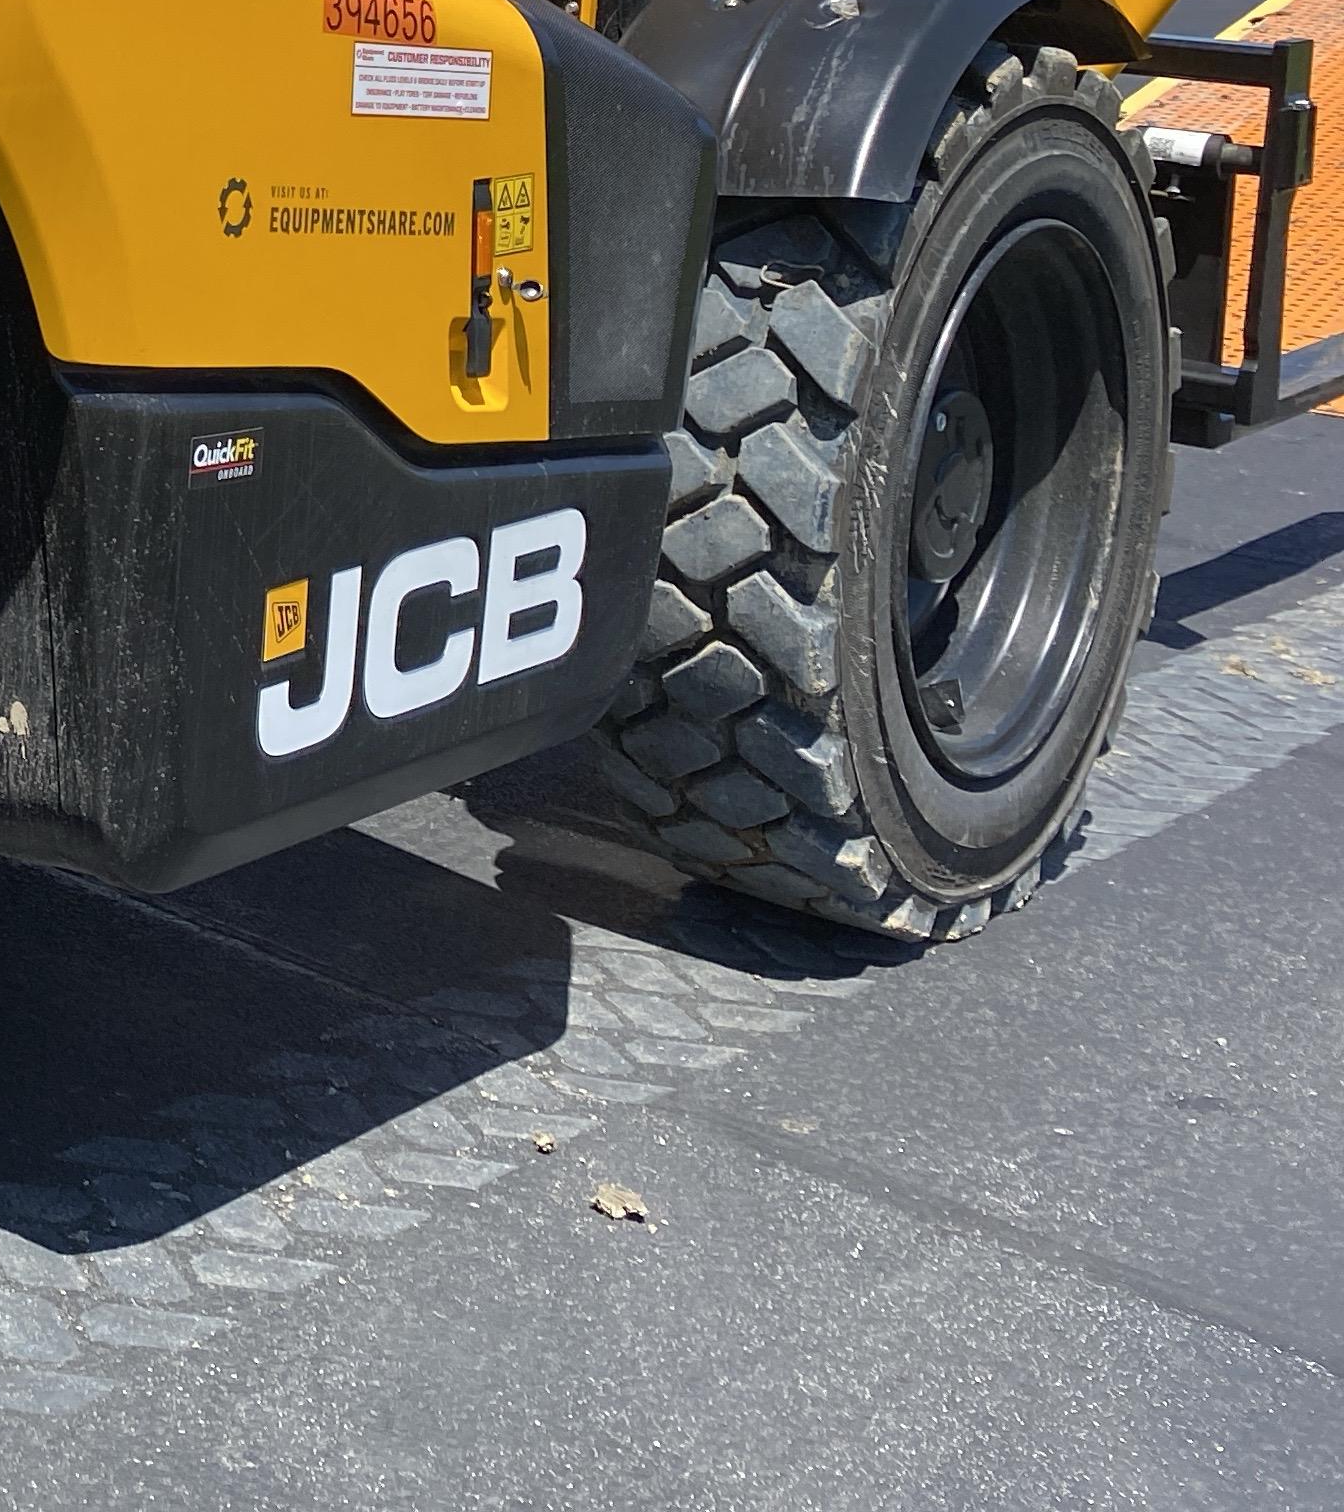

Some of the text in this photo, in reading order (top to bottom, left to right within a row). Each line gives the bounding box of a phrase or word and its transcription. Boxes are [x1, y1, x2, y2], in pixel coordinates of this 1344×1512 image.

[271, 186, 296, 199] VISIT
[299, 186, 311, 199] US
[269, 206, 456, 237] EQUIPMENTSHARE.COM
[192, 436, 255, 468] QuickFit
[216, 464, 254, 481] ONBOARD
[257, 507, 588, 758] JCB
[277, 605, 299, 638] JCB
